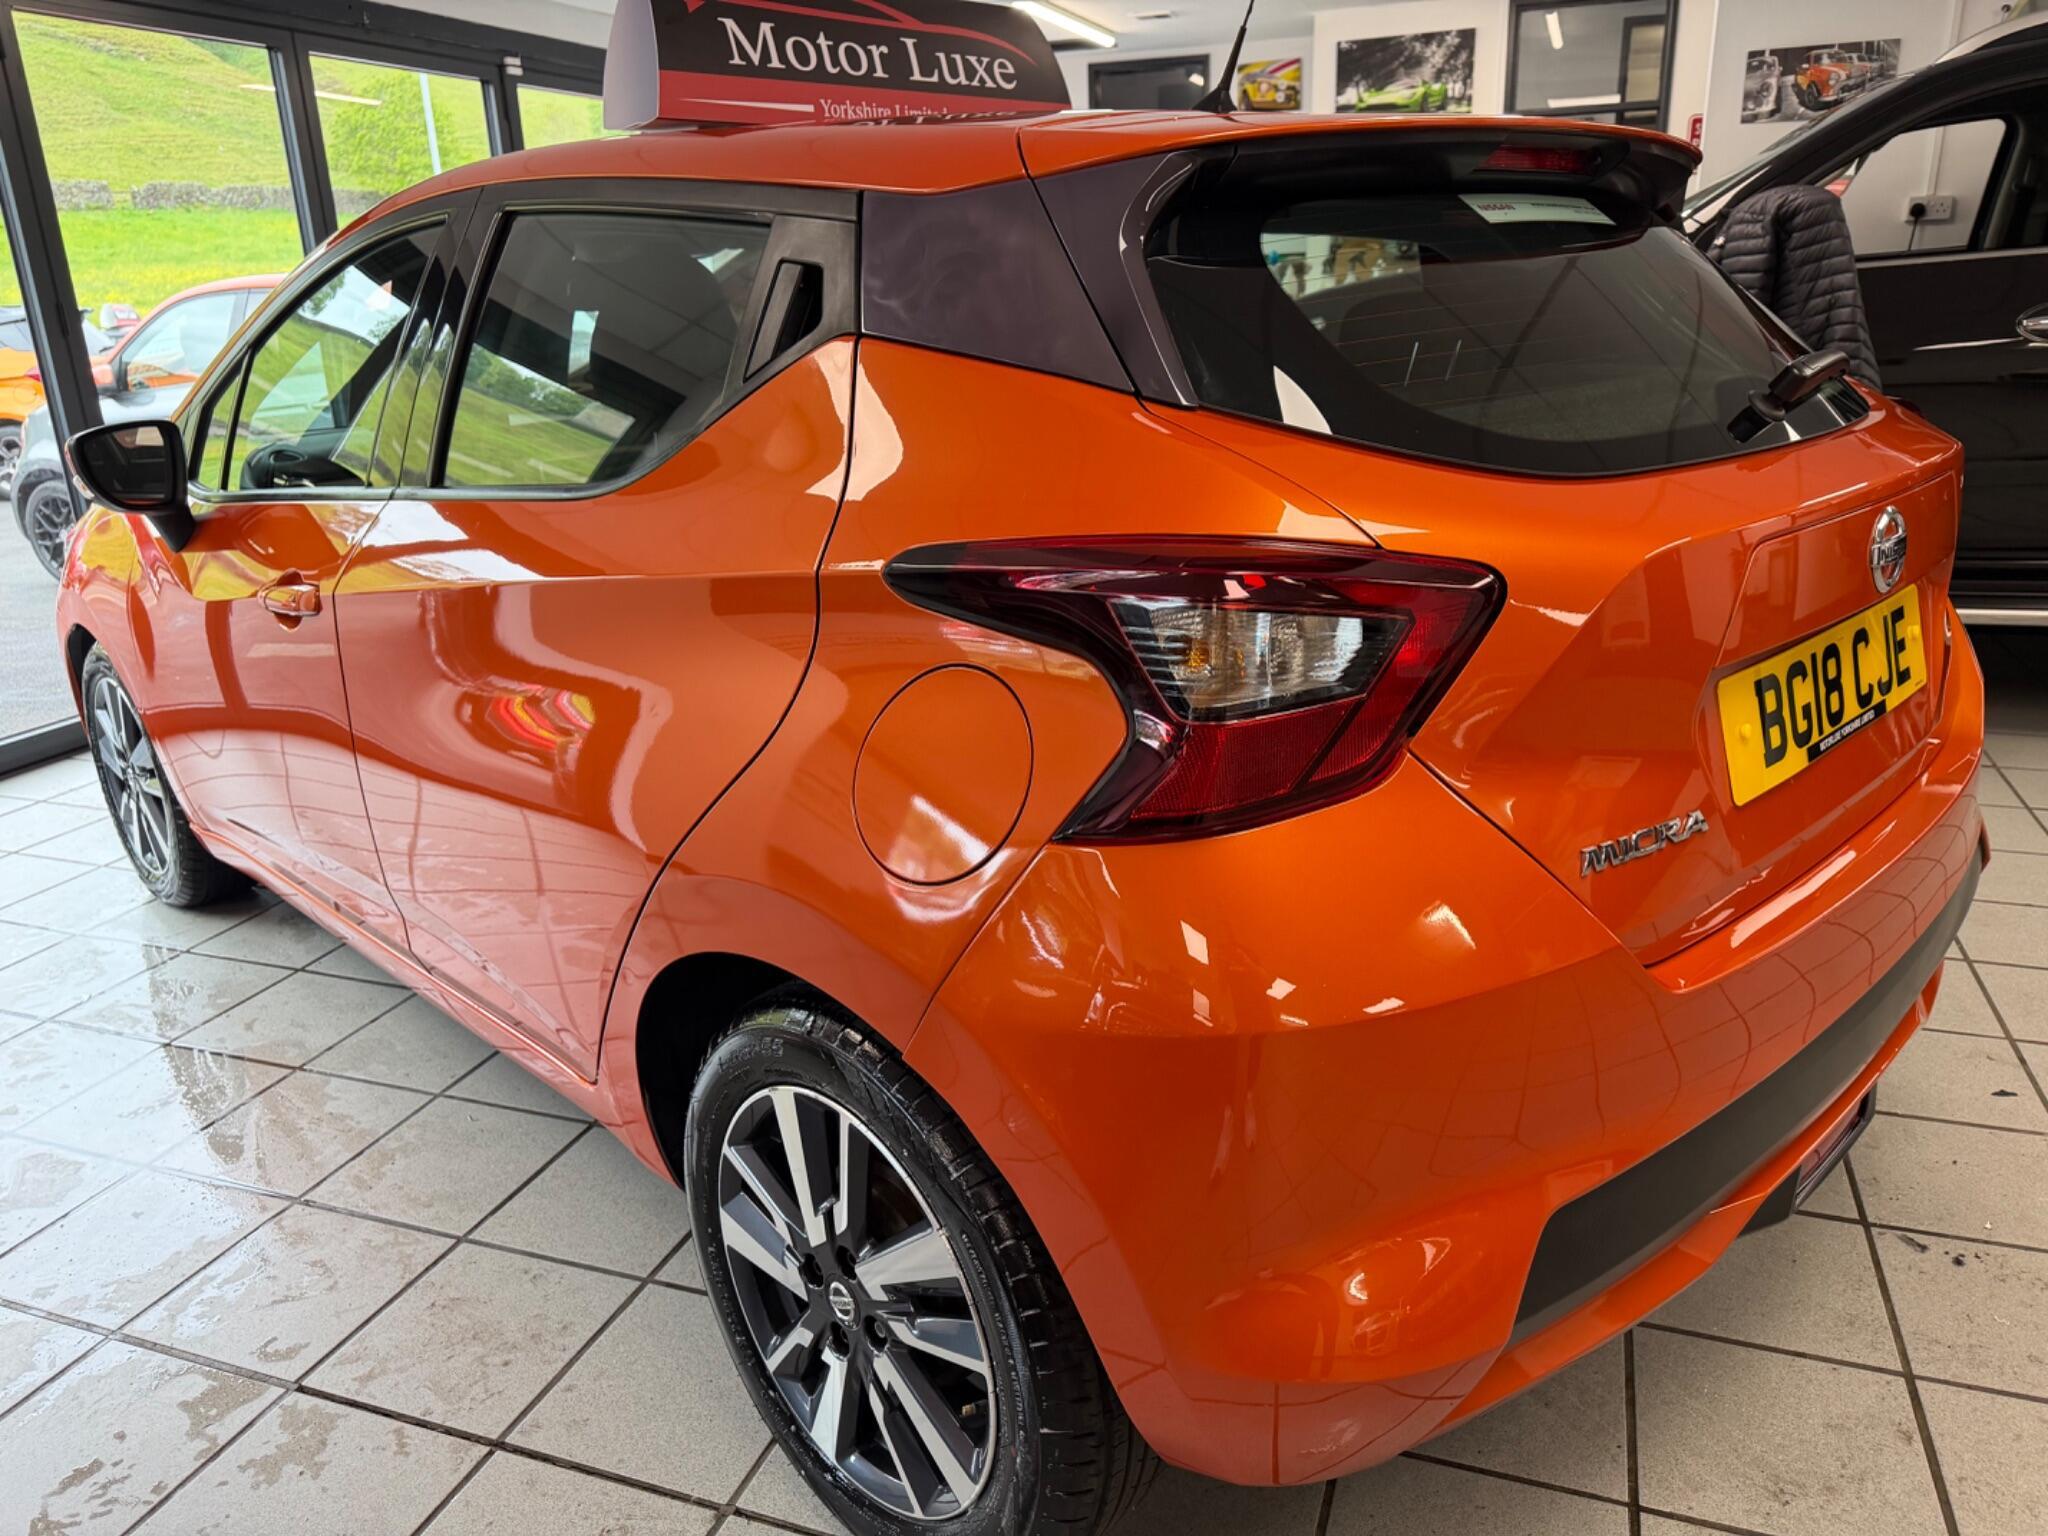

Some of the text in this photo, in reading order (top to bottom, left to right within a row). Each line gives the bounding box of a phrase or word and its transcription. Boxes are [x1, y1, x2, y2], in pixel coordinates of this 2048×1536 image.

[718, 16, 1018, 91] Motor Luxe
[819, 98, 891, 119] Yorkshire
[1754, 605, 1912, 769] BG18 CJE
[1580, 809, 1709, 877] MICRA
